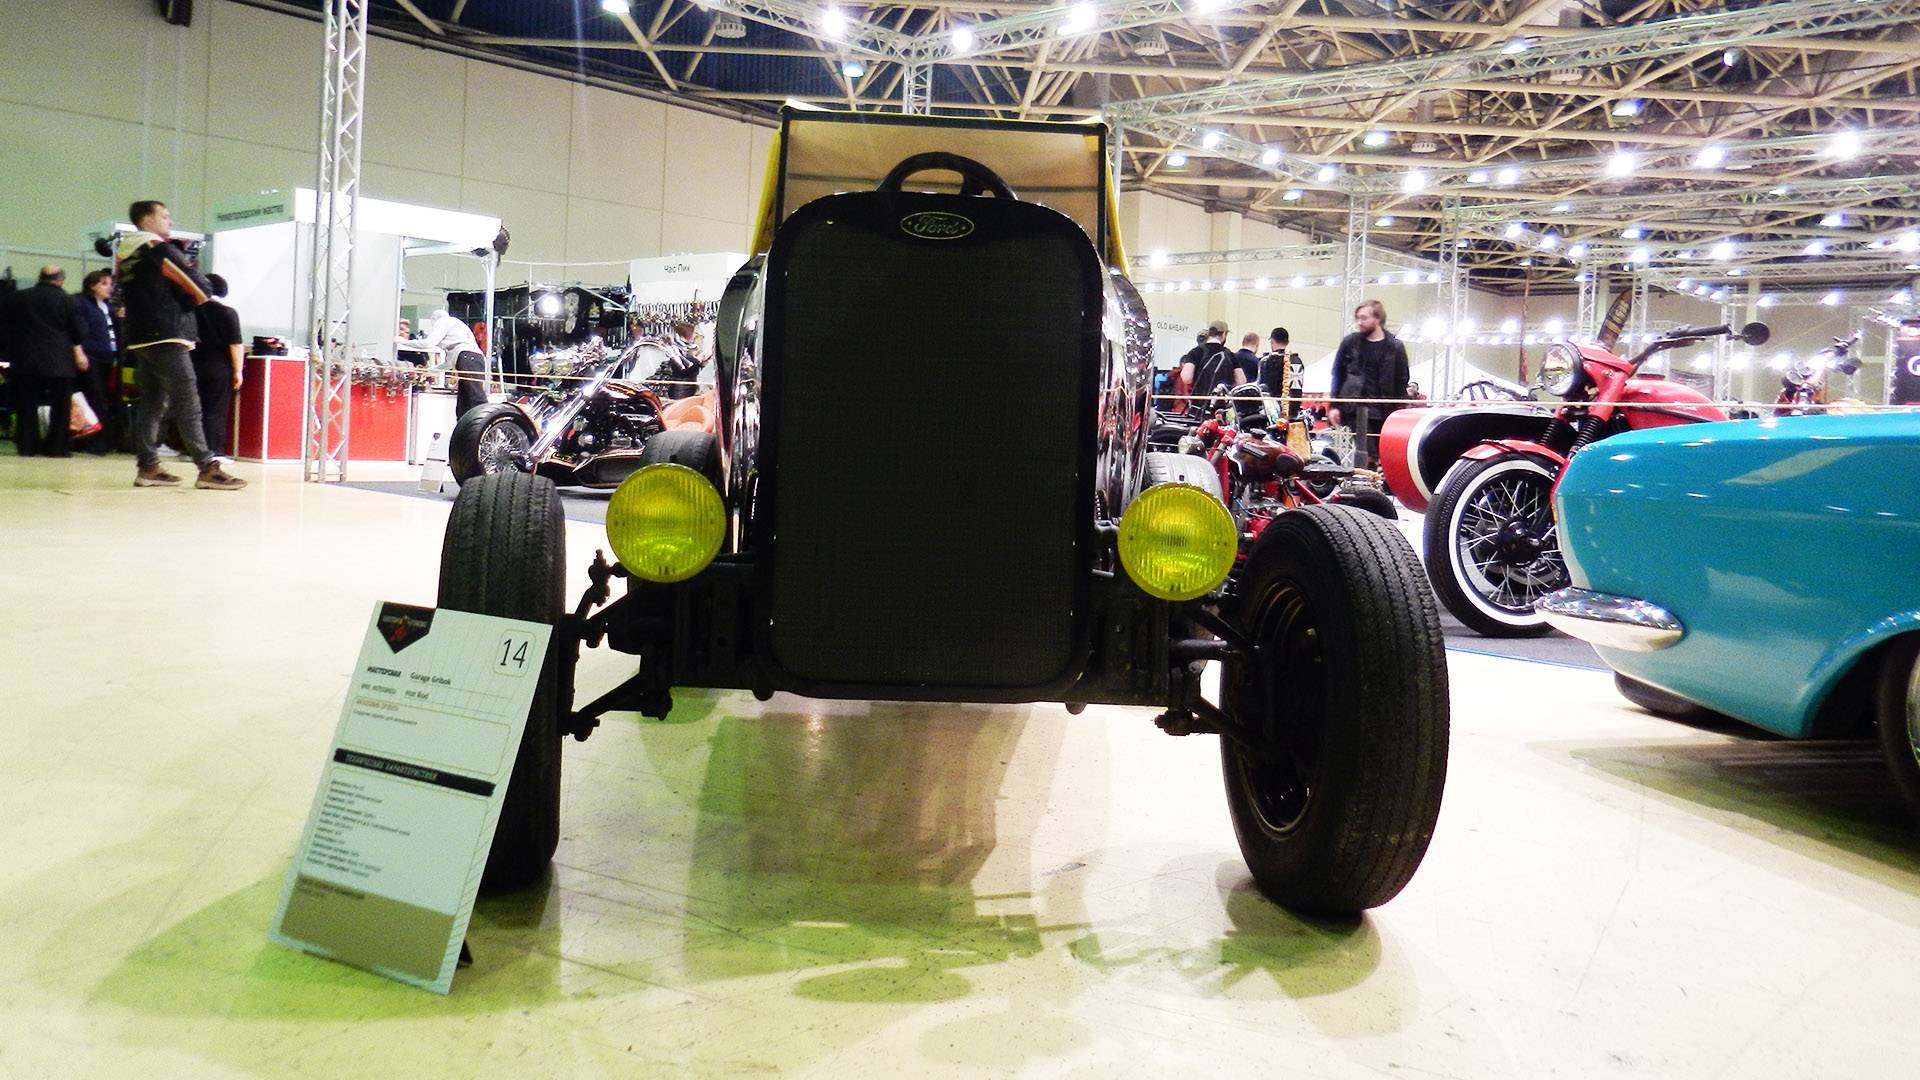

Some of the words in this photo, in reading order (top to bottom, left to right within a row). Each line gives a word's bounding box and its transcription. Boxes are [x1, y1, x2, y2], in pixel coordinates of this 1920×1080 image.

[914, 215, 961, 235] Ford
[1157, 321, 1168, 329] OLD
[500, 638, 529, 669] 14
[410, 672, 431, 684] Garage
